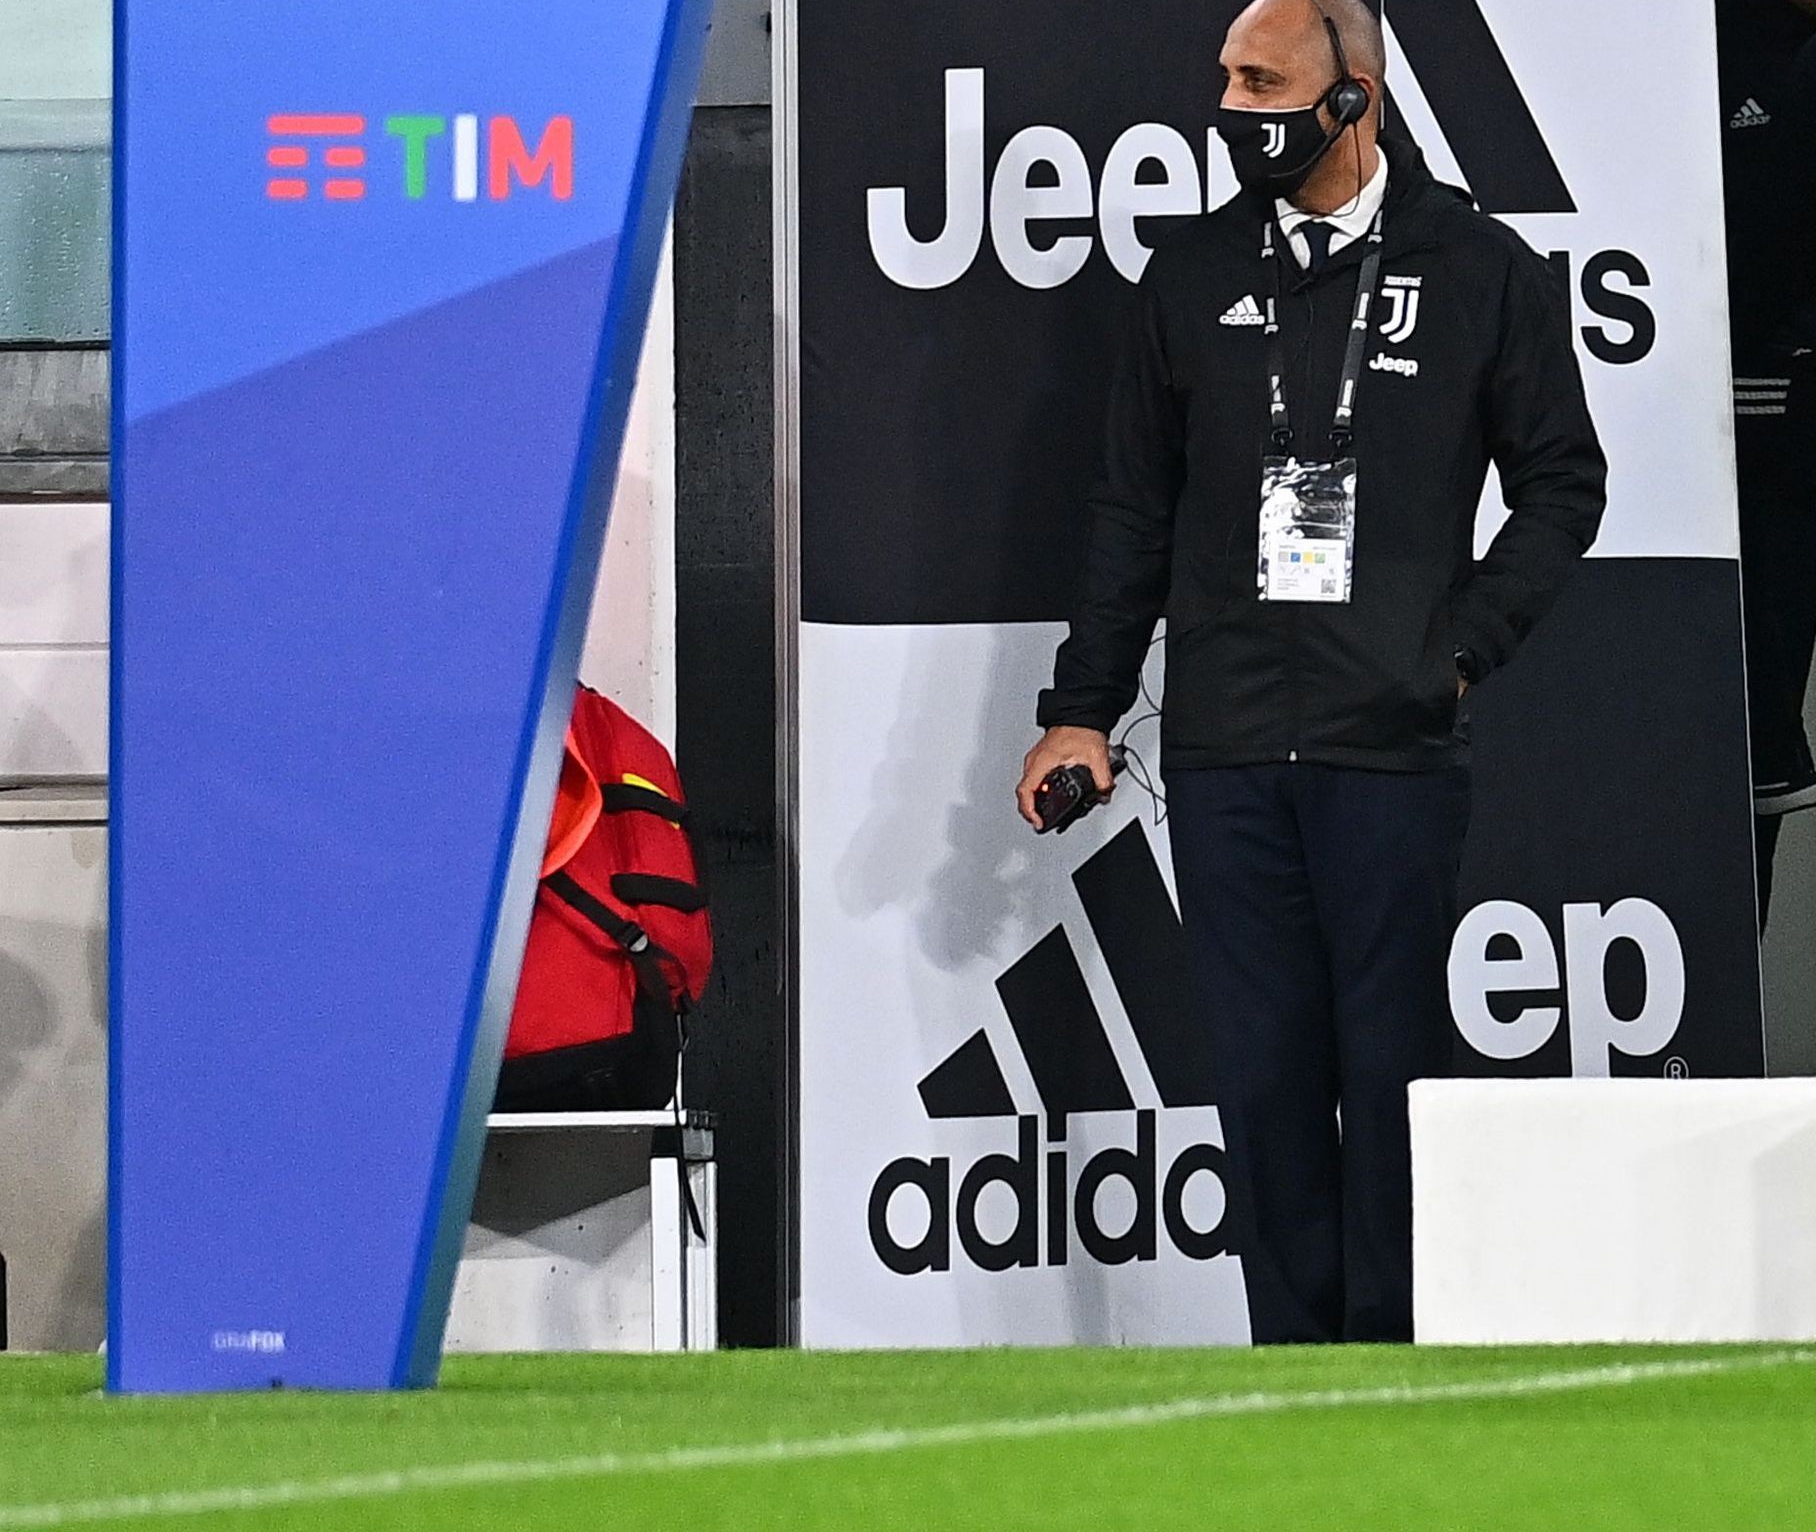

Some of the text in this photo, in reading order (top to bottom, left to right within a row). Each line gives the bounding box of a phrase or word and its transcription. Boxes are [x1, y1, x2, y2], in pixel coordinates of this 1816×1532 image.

[385, 113, 574, 202] TIM
[1368, 352, 1419, 377] Jeep
[867, 1111, 1241, 1276] adida
